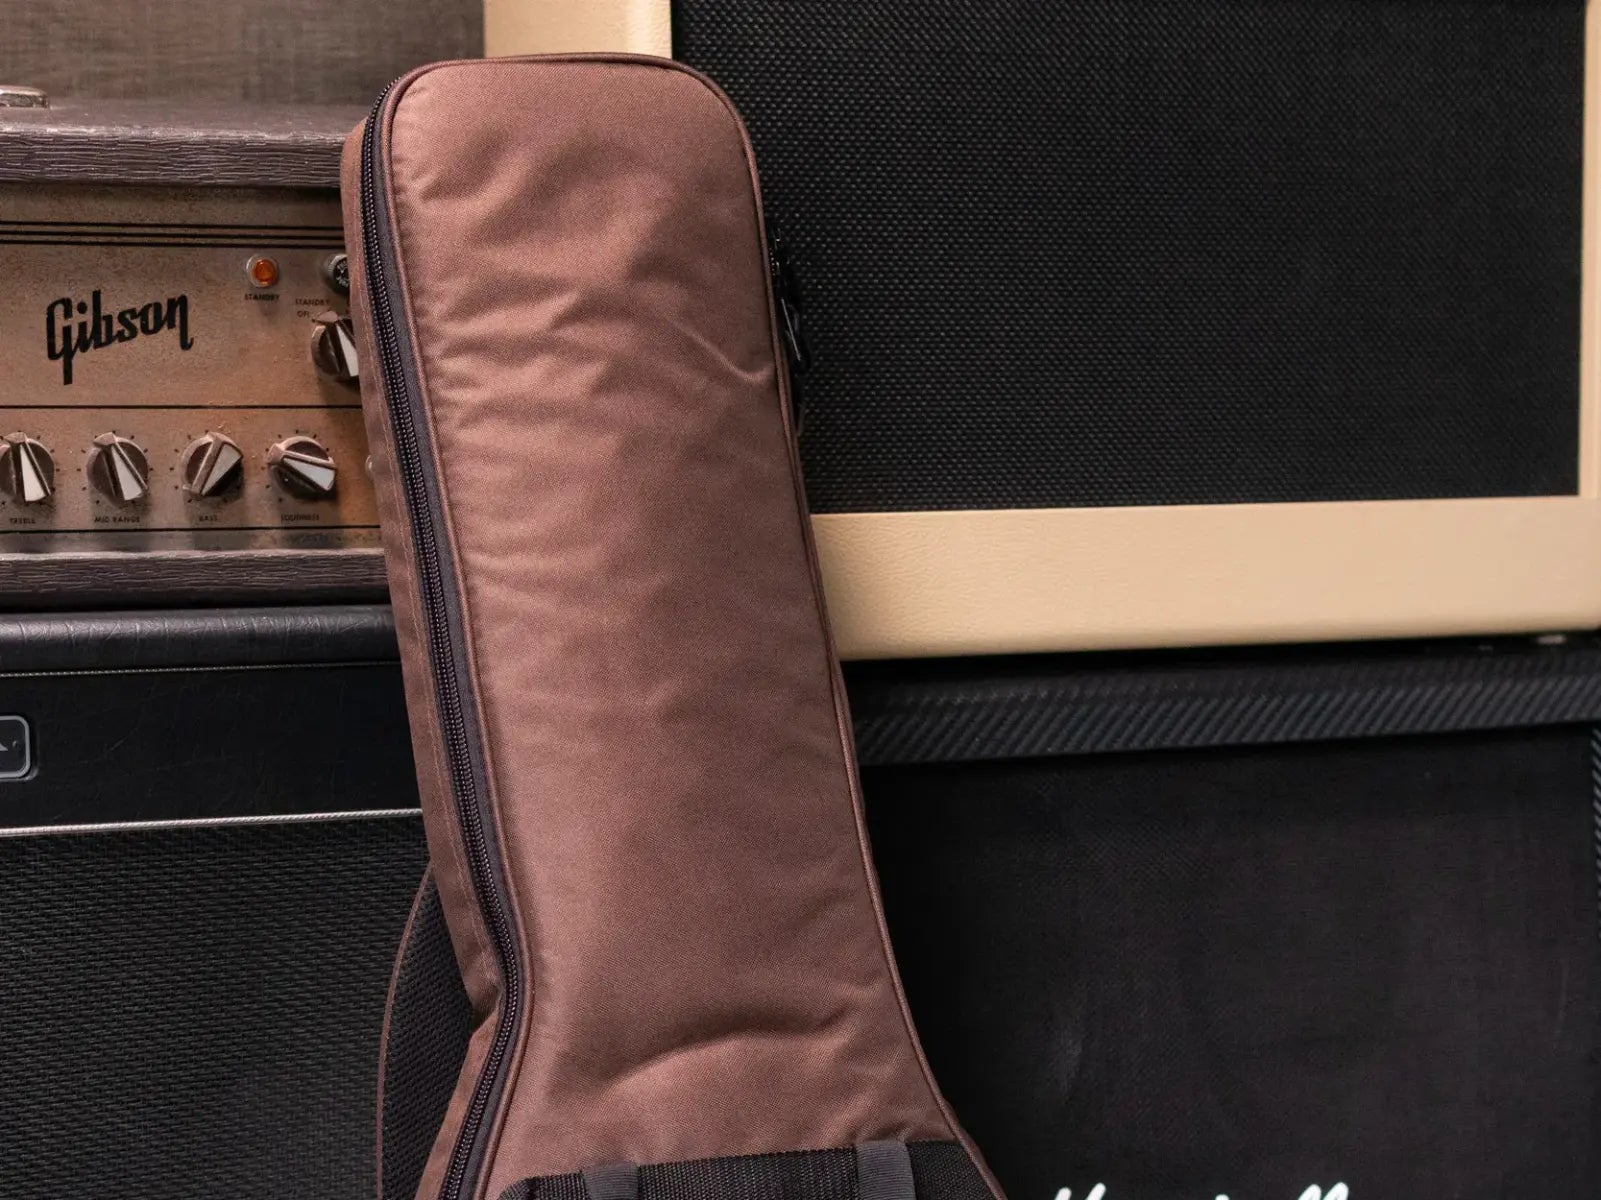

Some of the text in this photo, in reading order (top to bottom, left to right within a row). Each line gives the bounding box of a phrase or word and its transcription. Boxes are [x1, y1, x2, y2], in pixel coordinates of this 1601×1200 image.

[245, 293, 280, 301] STANDBY
[295, 298, 330, 306] STANDBY
[46, 290, 194, 385] Gibson
